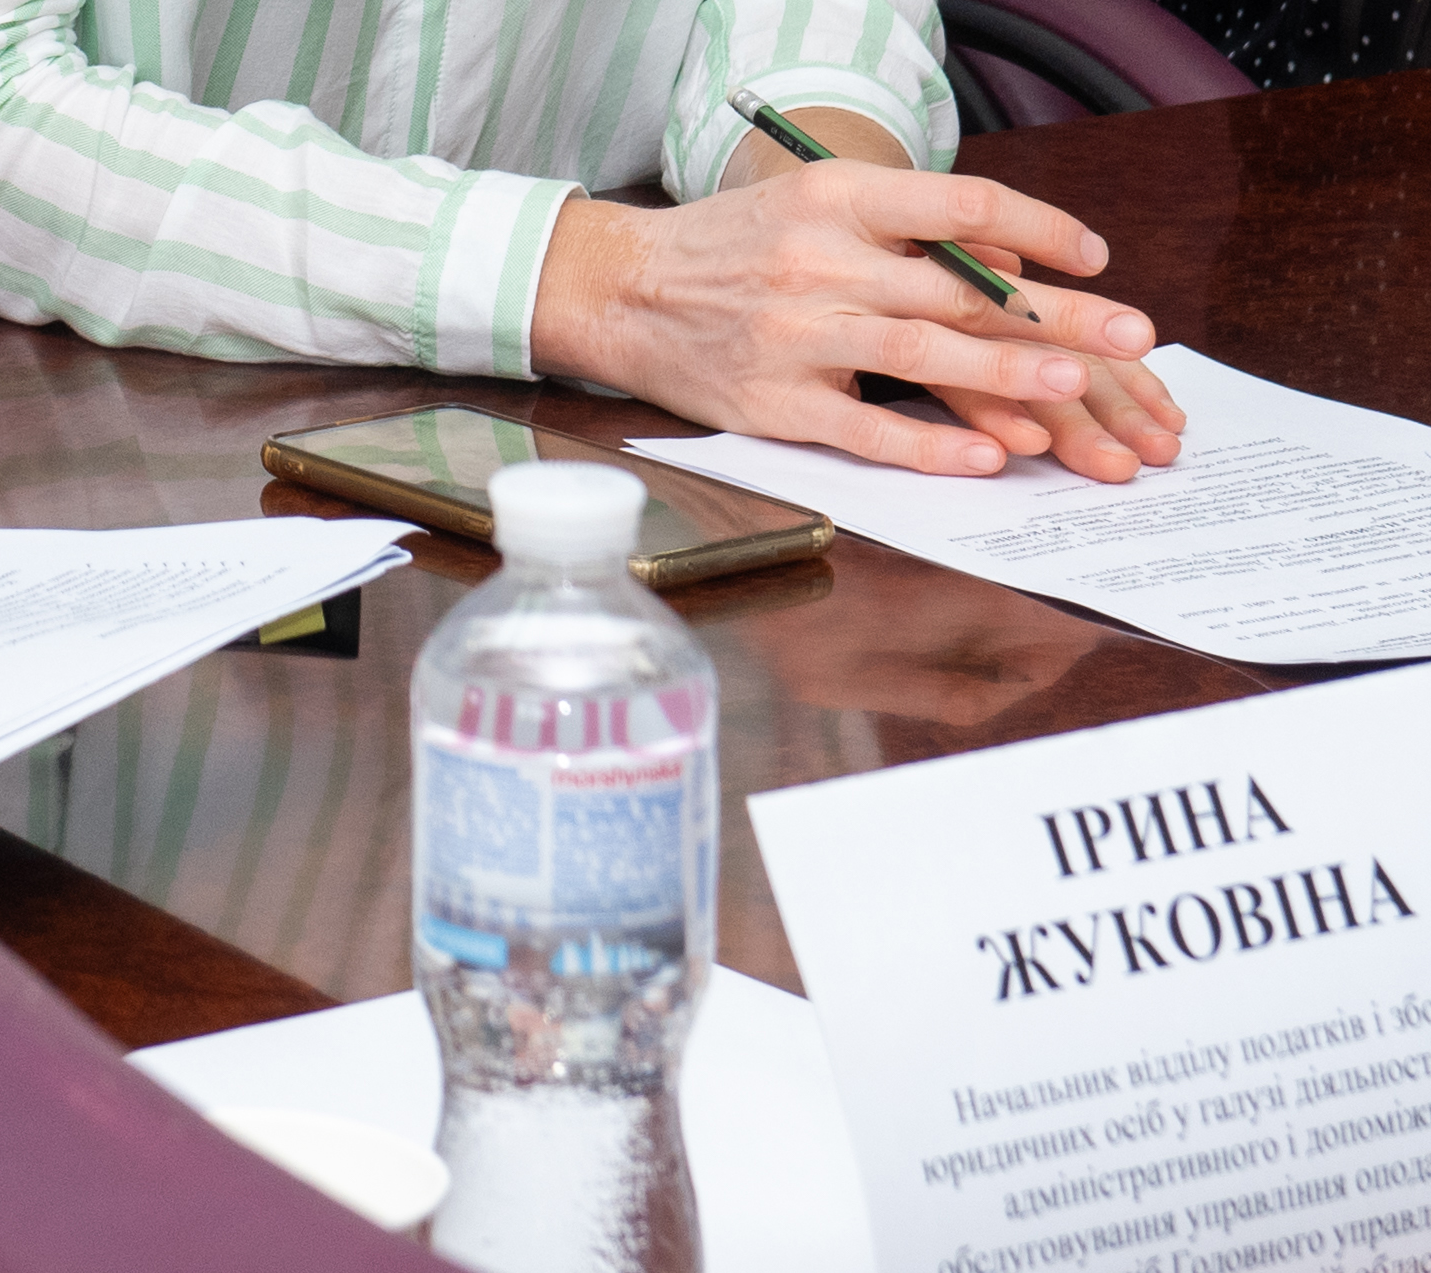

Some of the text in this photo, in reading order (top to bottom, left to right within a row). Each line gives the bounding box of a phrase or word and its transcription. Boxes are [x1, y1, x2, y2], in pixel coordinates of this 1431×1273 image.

[1039, 773, 1293, 880] ІРИНА
[977, 855, 1418, 1003] ЖУКОВІНА
[952, 1067, 1120, 1126] Начальник
[1126, 1039, 1231, 1089] відділу
[1239, 1007, 1366, 1065] податків
[1370, 999, 1386, 1037] і
[922, 1123, 1097, 1190] юридичних
[1103, 1097, 1167, 1146] осіб
[1171, 1103, 1190, 1141] у
[1198, 1073, 1287, 1127] галузі
[1004, 1136, 1280, 1222] адміністративного
[1286, 1122, 1299, 1158] і
[1185, 1174, 1347, 1243] управління
